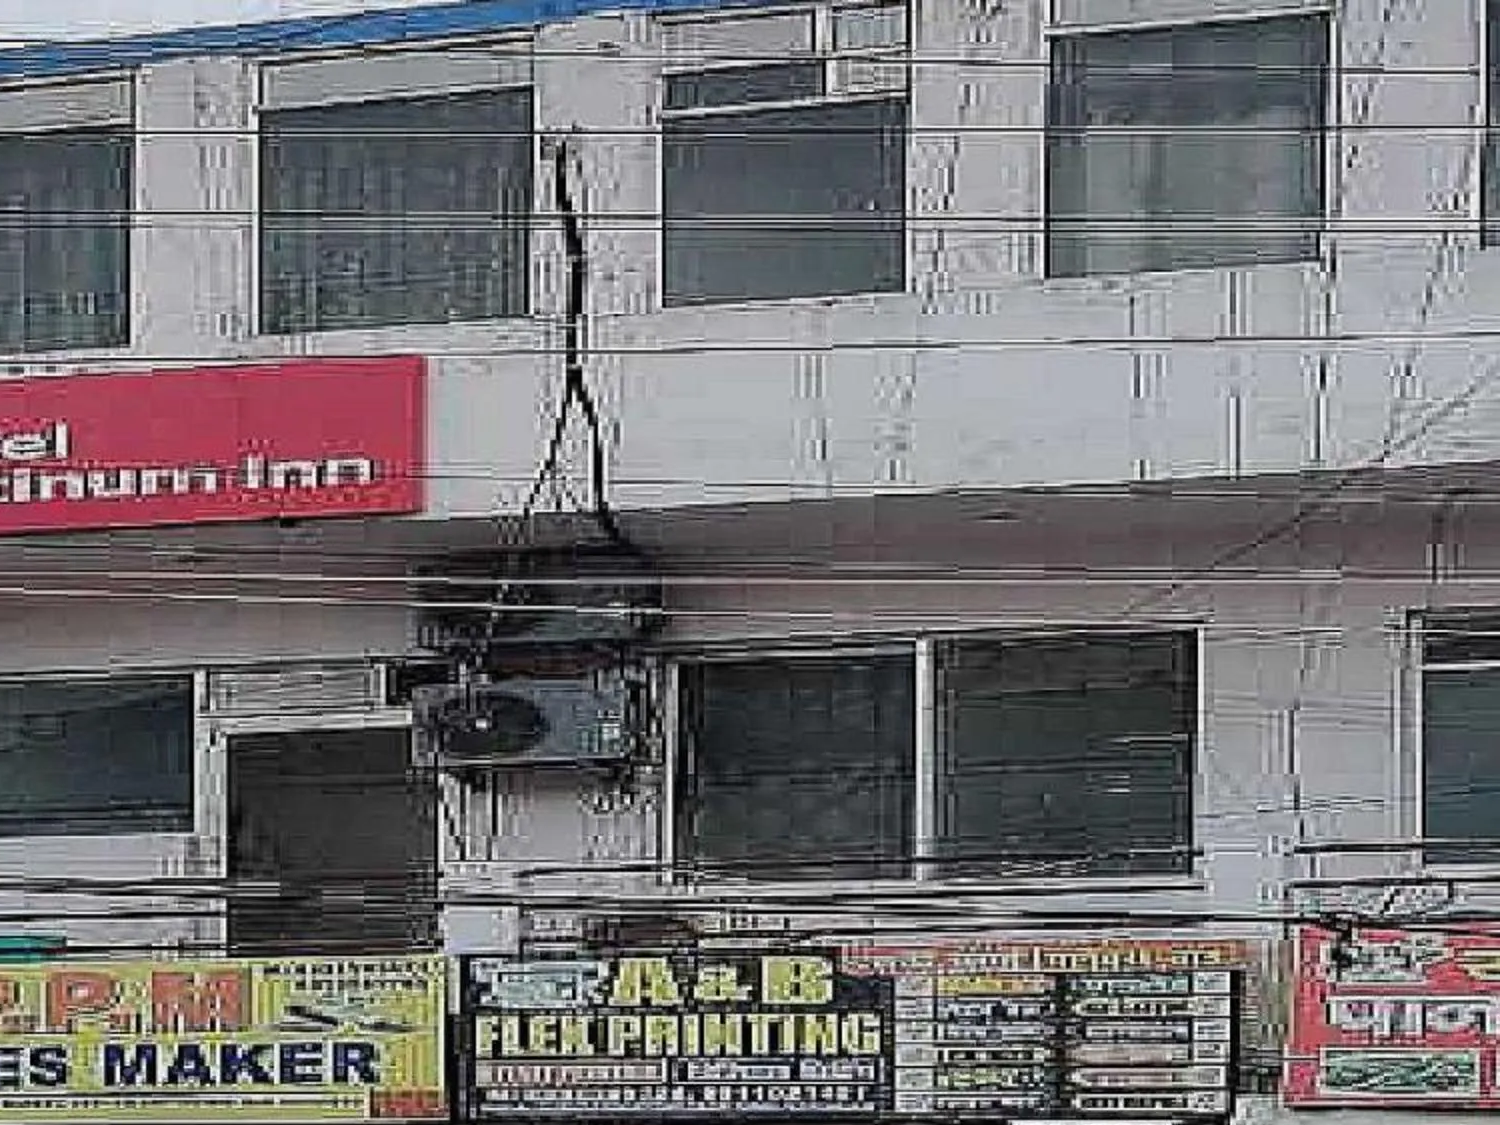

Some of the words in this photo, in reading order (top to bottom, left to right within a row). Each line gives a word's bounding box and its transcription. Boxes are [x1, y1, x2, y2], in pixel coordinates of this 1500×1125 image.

[246, 452, 375, 488] Inn
[613, 957, 678, 1005] A
[762, 956, 834, 1004] B
[476, 1013, 594, 1058] FLEX
[608, 1013, 883, 1058] PRINTING
[104, 1041, 380, 1088] MAKER
